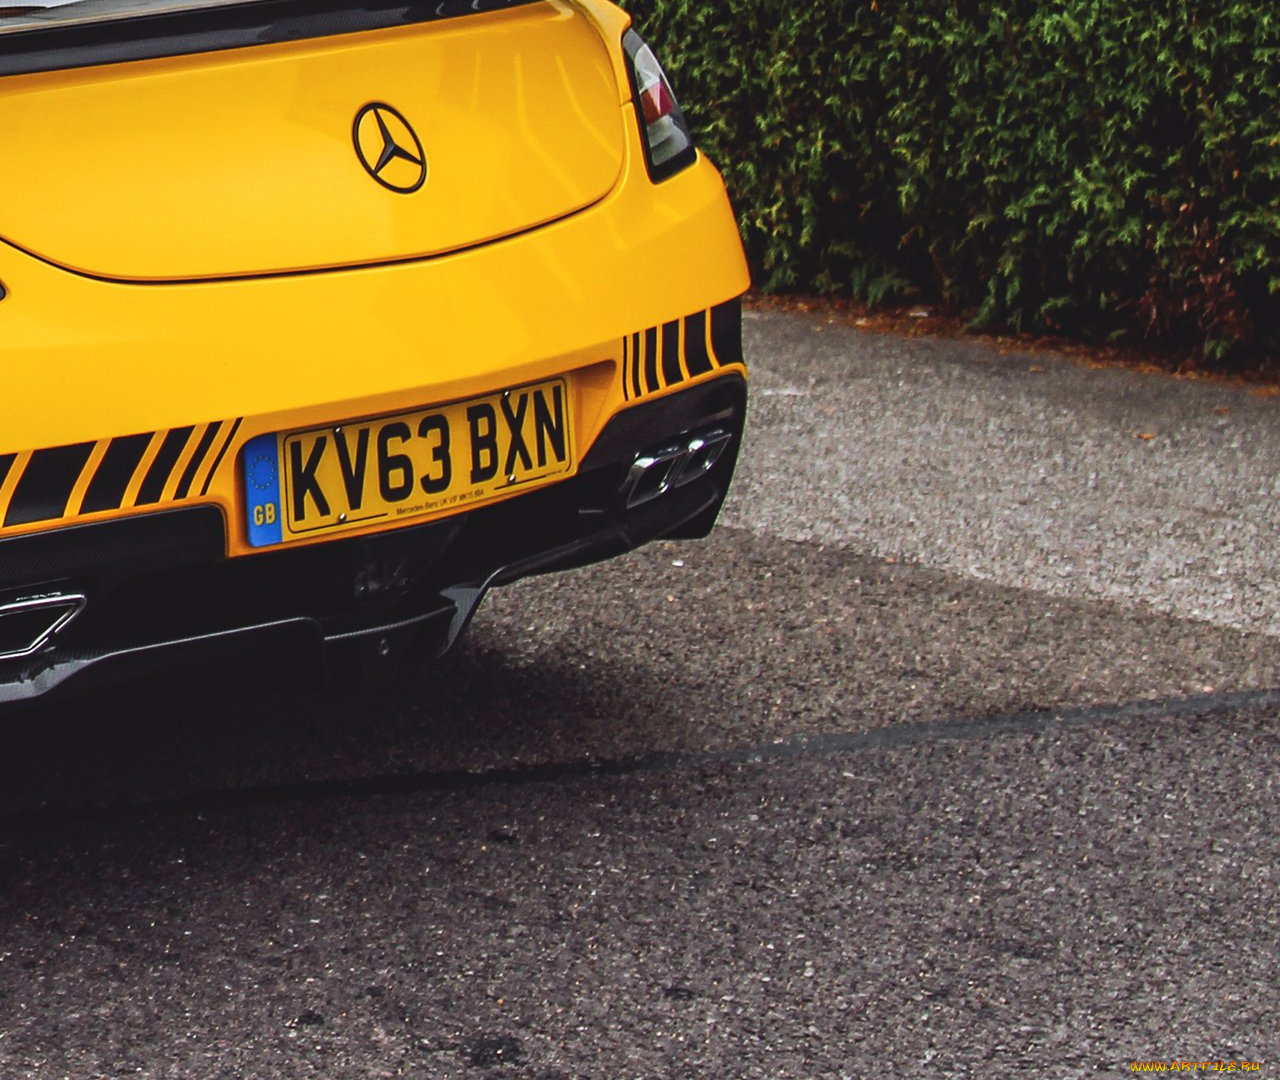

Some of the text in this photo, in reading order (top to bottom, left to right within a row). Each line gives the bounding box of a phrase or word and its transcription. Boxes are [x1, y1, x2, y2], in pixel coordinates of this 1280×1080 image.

[291, 386, 566, 521] KV63 BXN
[253, 502, 276, 526] GB
